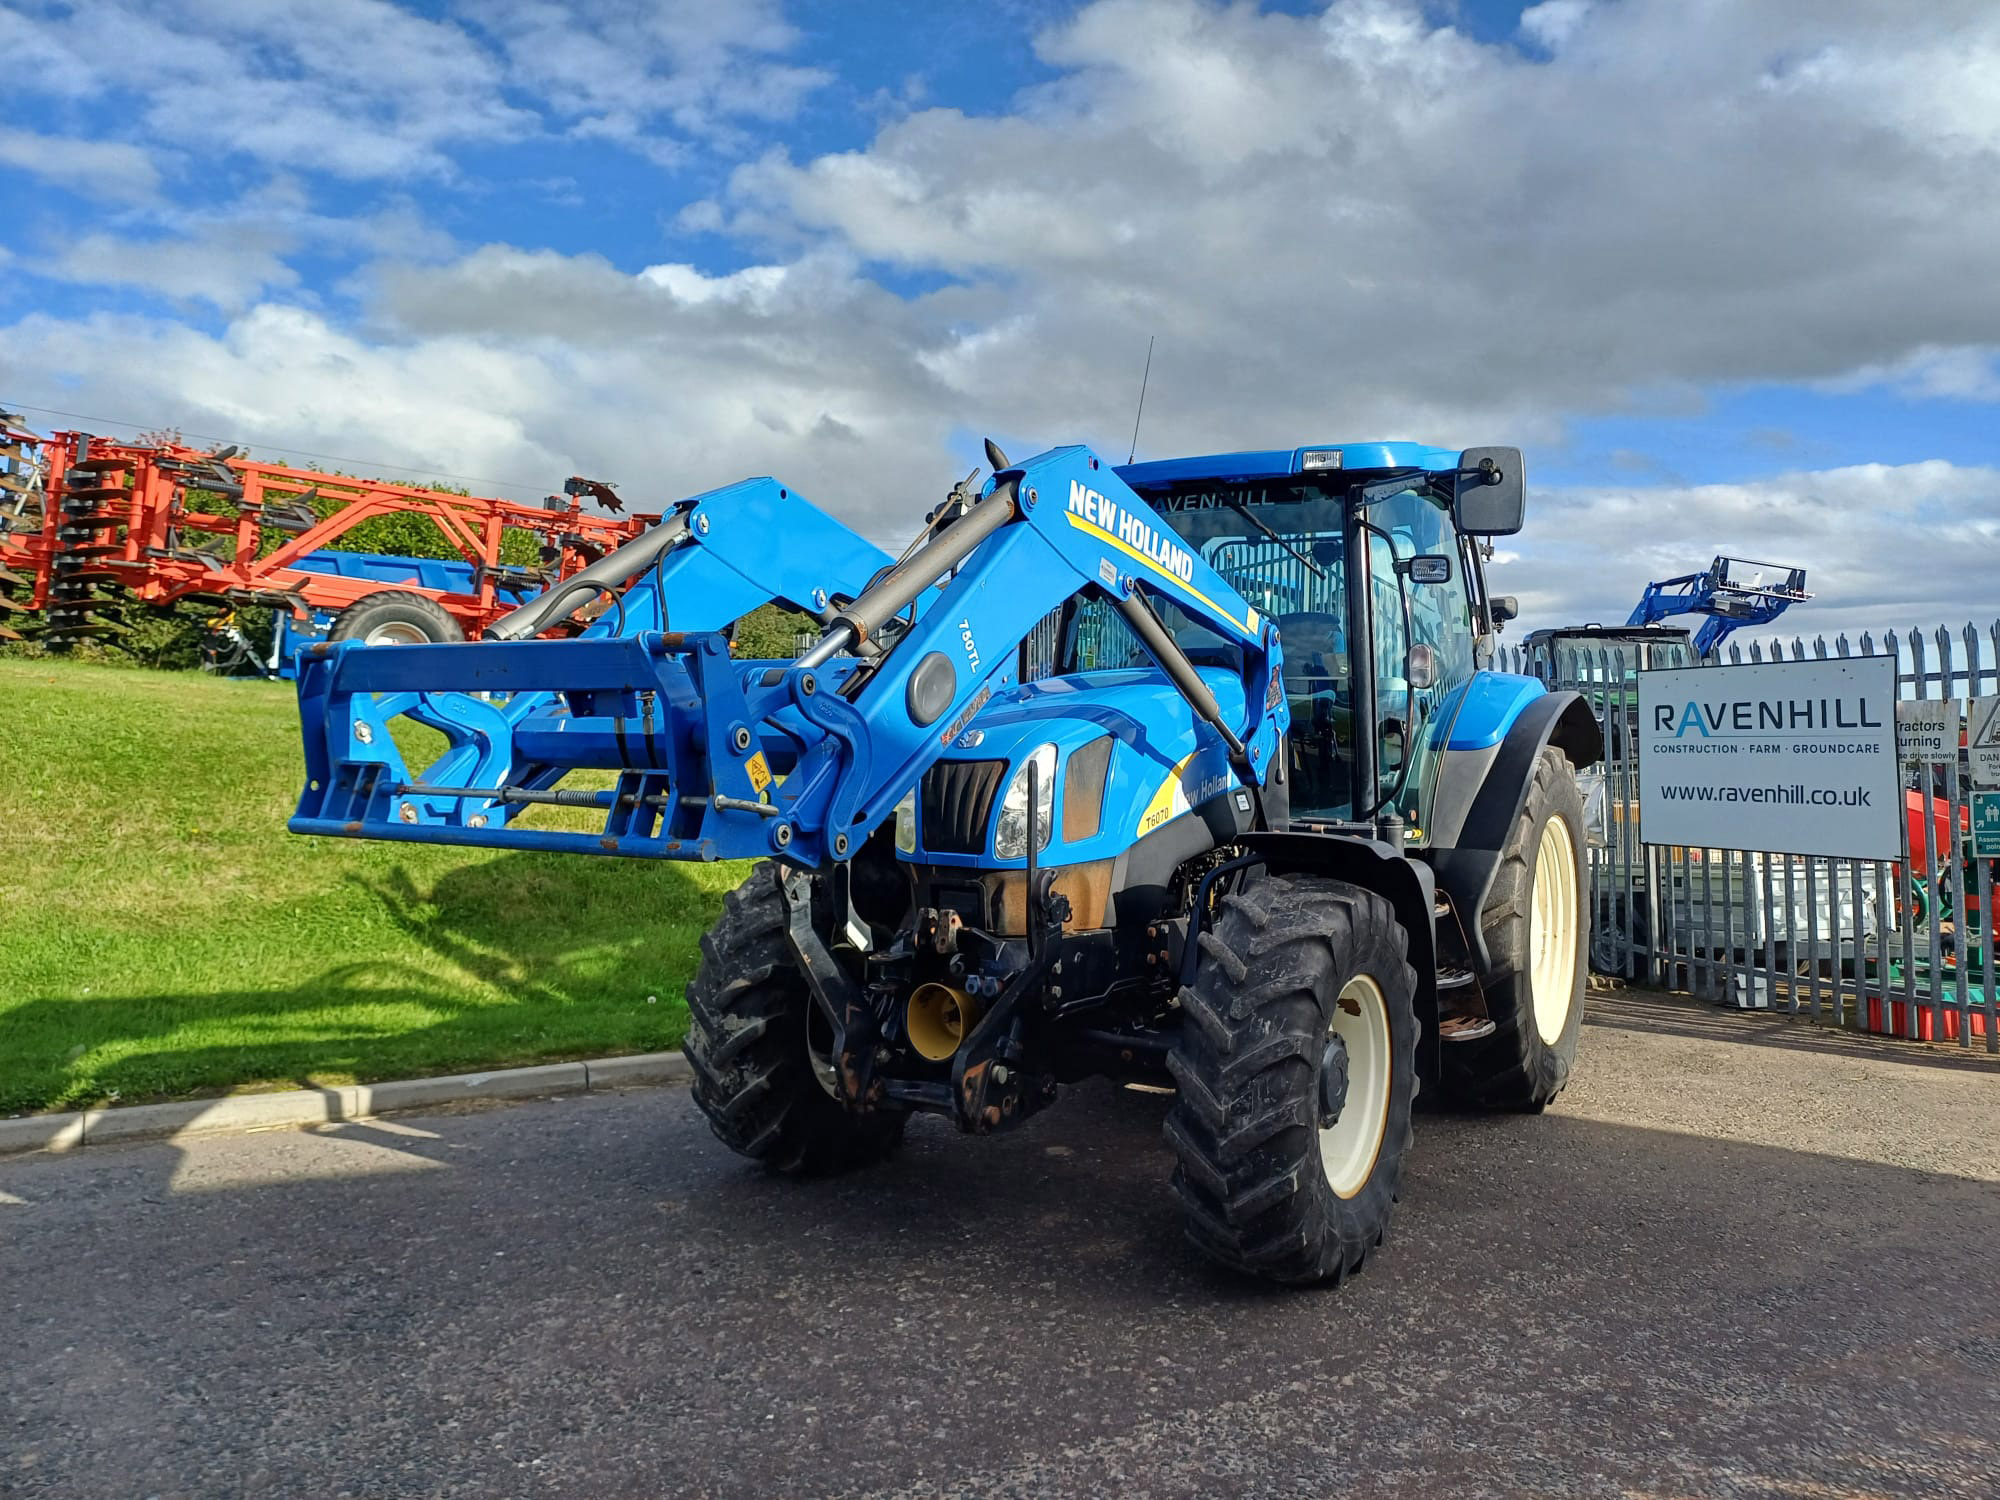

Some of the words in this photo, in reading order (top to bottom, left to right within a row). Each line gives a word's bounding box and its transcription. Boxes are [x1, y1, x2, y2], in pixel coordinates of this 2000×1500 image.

[1152, 489, 1275, 514] AVENILL
[1068, 479, 1118, 534] NEW
[1118, 508, 1194, 584] HOLLAND
[958, 618, 980, 674] 750TL
[1654, 698, 1882, 738] RAVENHILL
[1653, 744, 1738, 754] CONSTRUCTION
[1749, 744, 1781, 754] FARM
[1792, 743, 1880, 754] GROUNDCARE
[1910, 752, 1929, 760] drive
[1931, 752, 1956, 761] slowly
[1661, 784, 1871, 807] www.ravenhill.co.uk
[1146, 807, 1169, 829] T6070
